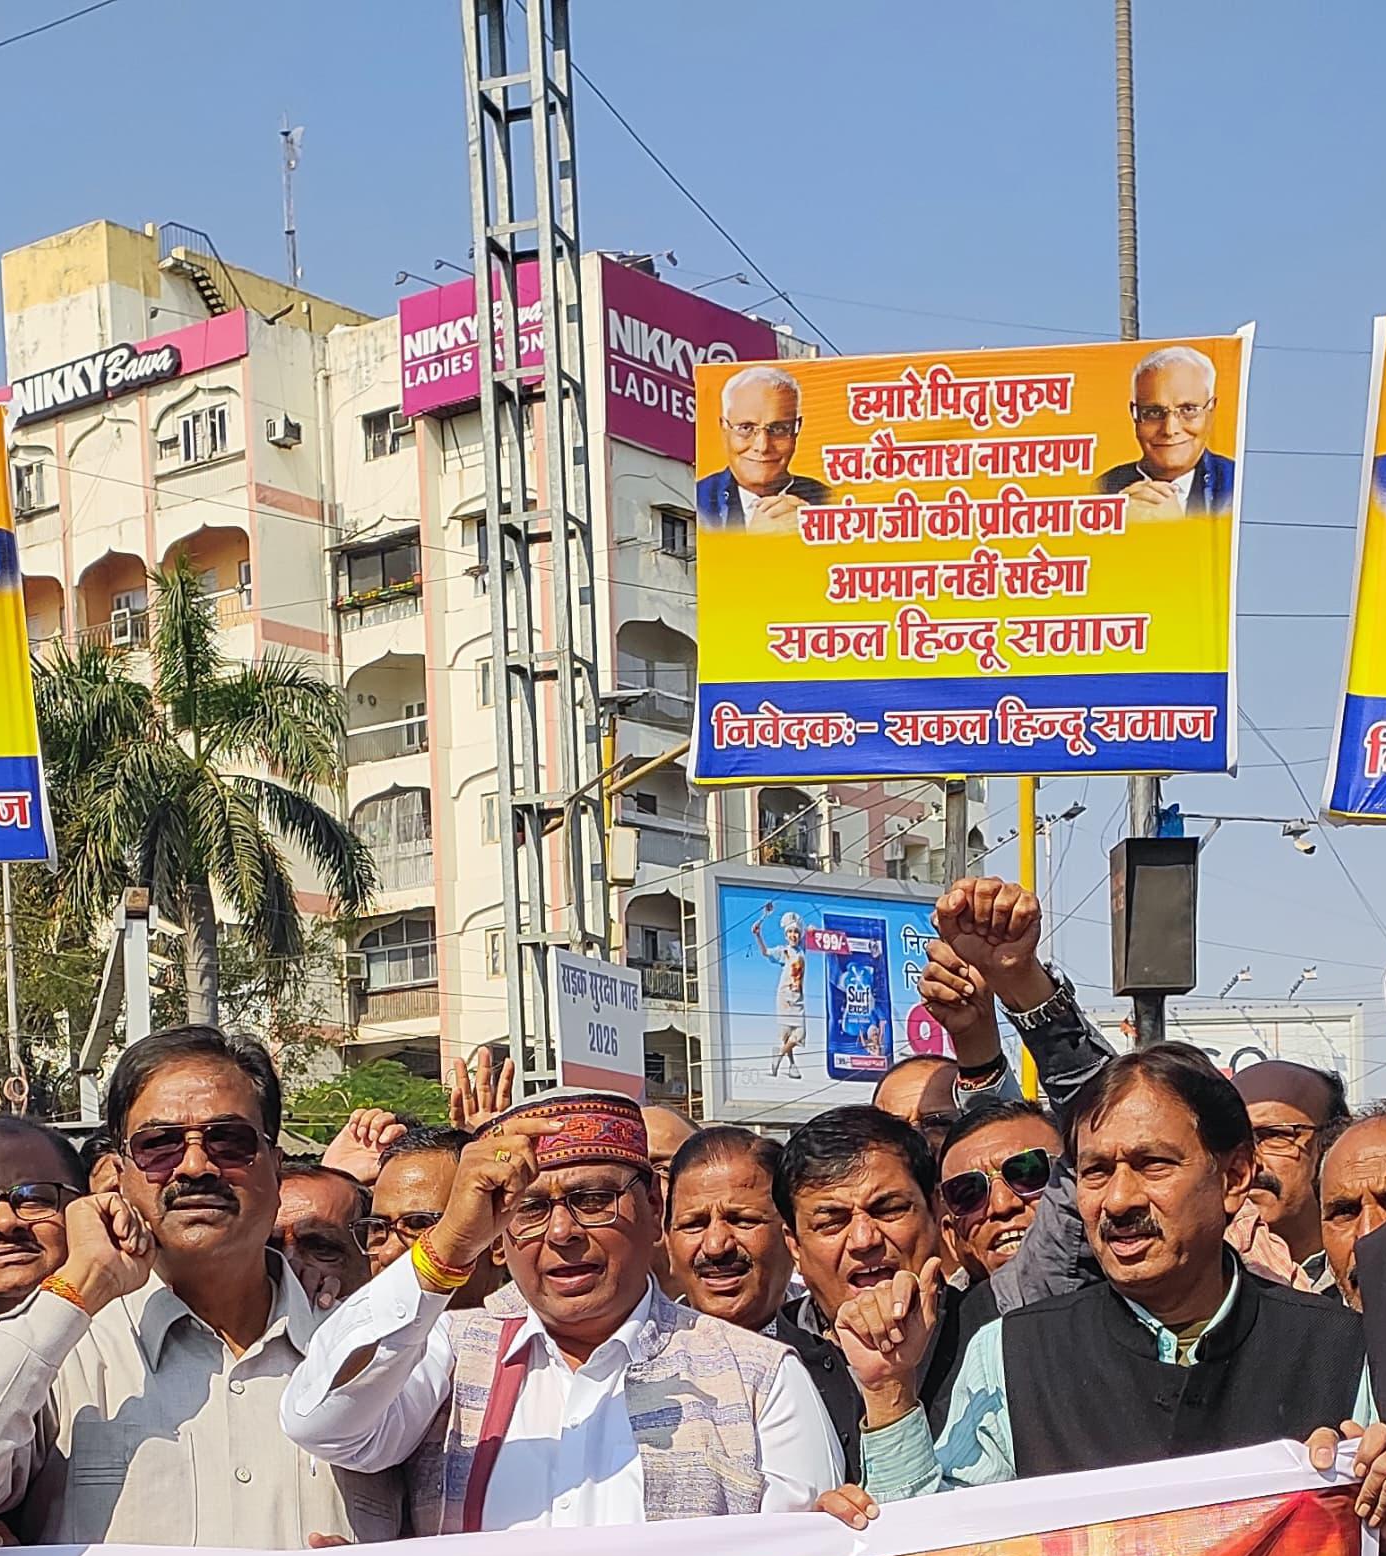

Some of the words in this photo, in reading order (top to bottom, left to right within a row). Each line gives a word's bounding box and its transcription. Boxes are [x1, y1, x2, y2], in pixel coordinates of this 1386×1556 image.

[403, 314, 478, 361] NIKKY
[609, 309, 706, 379] NIKKY
[13, 354, 106, 415] NIKKY
[105, 348, 173, 387] Bawa
[404, 352, 473, 388] LADIES
[610, 365, 695, 423] LADIES
[851, 374, 923, 422] हमारे
[929, 367, 990, 424] पितृ
[996, 378, 1071, 421] पुरुष
[979, 440, 1093, 474] नारायण
[800, 502, 876, 543] सारंग
[883, 494, 923, 538] जी
[928, 491, 969, 536] की
[978, 487, 1072, 539] प्रतिमा
[1079, 499, 1124, 532] का
[830, 564, 936, 600] अपमान
[943, 553, 998, 596] नहीं
[1004, 550, 1086, 594] सहेगा
[769, 625, 886, 659] सकल
[899, 611, 1006, 670] हिन्दू
[1009, 616, 1148, 654] समाज
[885, 709, 990, 742] सकल
[998, 700, 1094, 753] हिन्दू
[1093, 707, 1215, 740] समाज
[561, 964, 586, 1004] सड़क
[589, 972, 617, 1013] सुरक्षा
[619, 980, 638, 1011] माह
[848, 985, 870, 1003] Surf
[848, 1003, 870, 1015] excel
[589, 1022, 618, 1056] 2026
